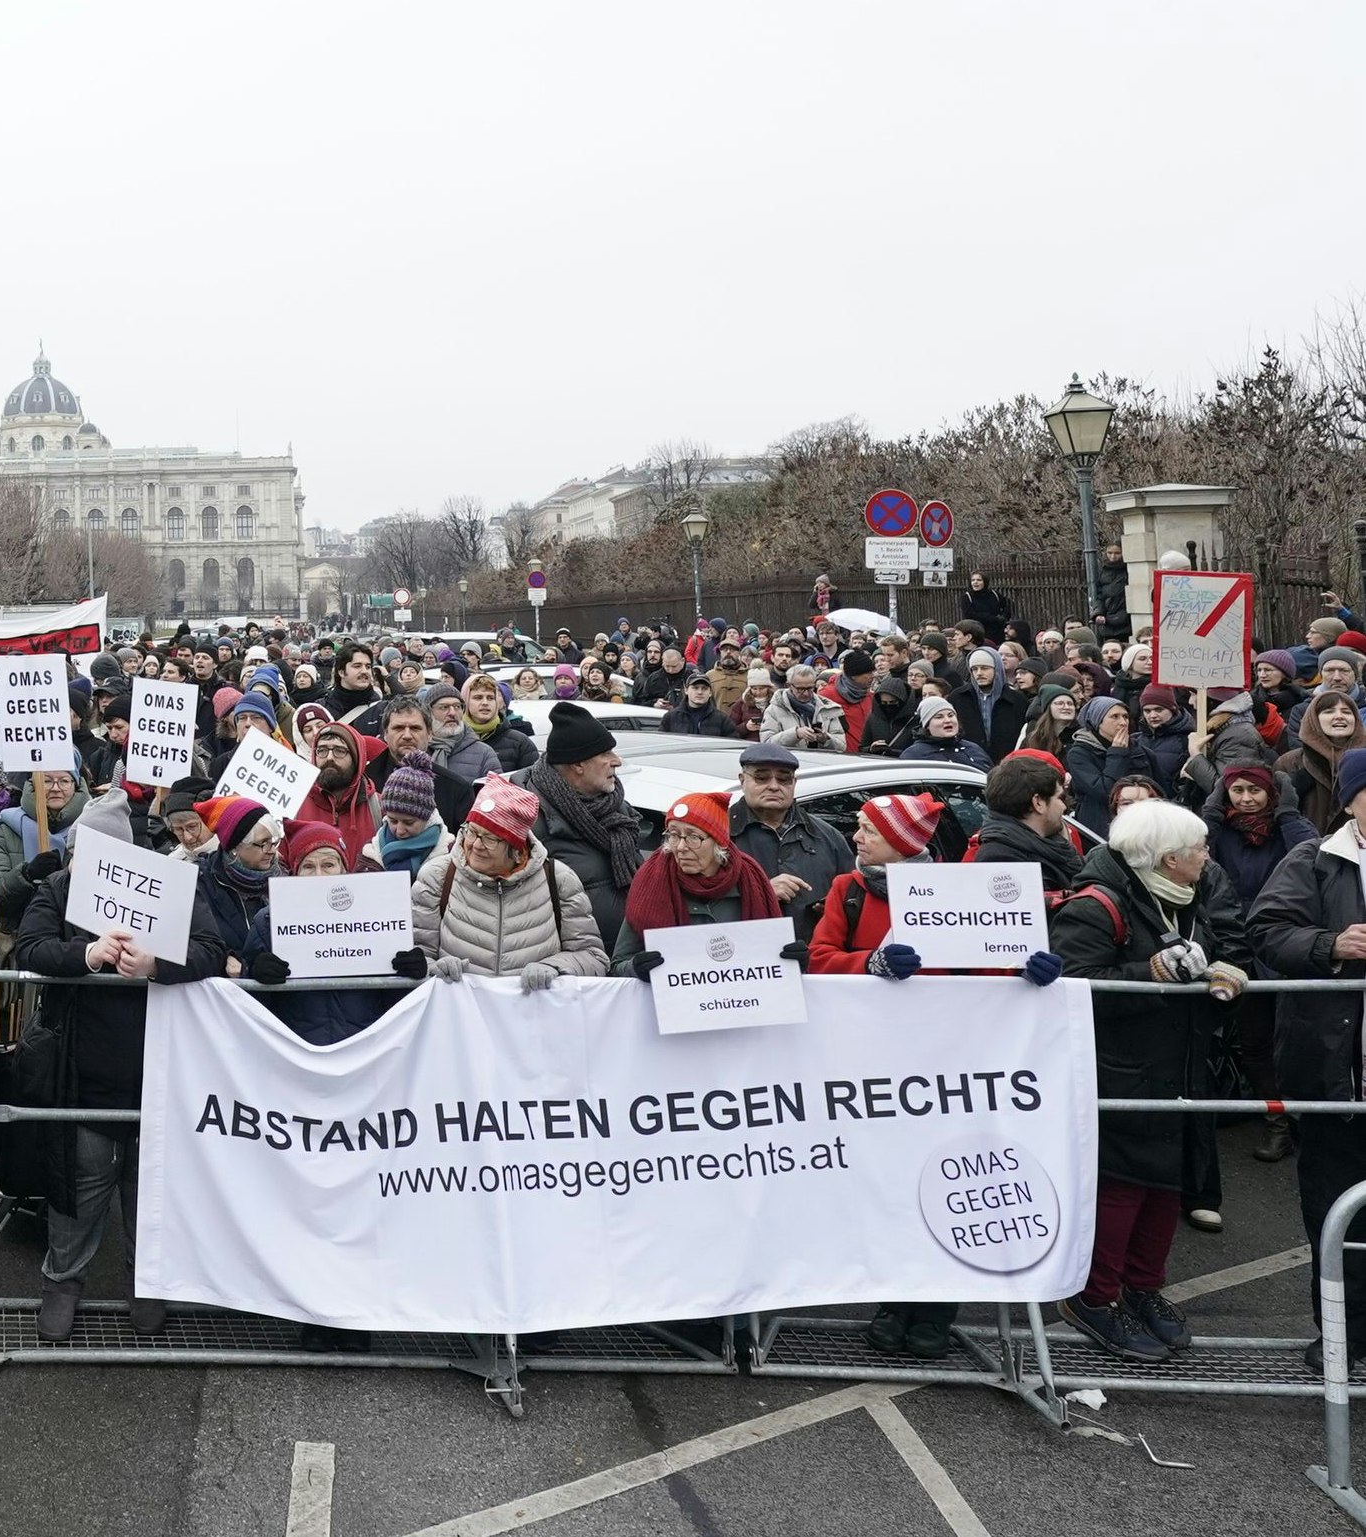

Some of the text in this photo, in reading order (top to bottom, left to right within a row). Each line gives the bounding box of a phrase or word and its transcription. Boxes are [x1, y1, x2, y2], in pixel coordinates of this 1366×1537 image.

[9, 671, 52, 686] OMAS
[7, 699, 59, 714] GEGEN
[145, 694, 183, 710] OMAS
[5, 726, 66, 742] RECHTS
[138, 718, 185, 736] GEGEN
[132, 742, 187, 763] RECHTS
[254, 749, 297, 782] OMAS
[237, 767, 290, 807] GEGEN
[98, 860, 162, 898] HETZE
[909, 886, 933, 895] Aus
[94, 894, 157, 932] TÖTET
[904, 912, 1032, 925] GESCHICHTE
[278, 920, 406, 935] MENSCHENRECHTE
[315, 948, 371, 958] schützen
[985, 943, 1027, 952] lernen
[668, 965, 782, 986] DEMOKRATIE
[700, 999, 758, 1010] schützen
[196, 1070, 1041, 1153] ABSTAND HALTEN GEGEN RECHTS
[378, 1135, 848, 1197] www.omasgegenrechts.at
[941, 1148, 1018, 1180] OMAS
[947, 1181, 1032, 1214] GEGEN
[952, 1214, 1049, 1250] RECHTS
